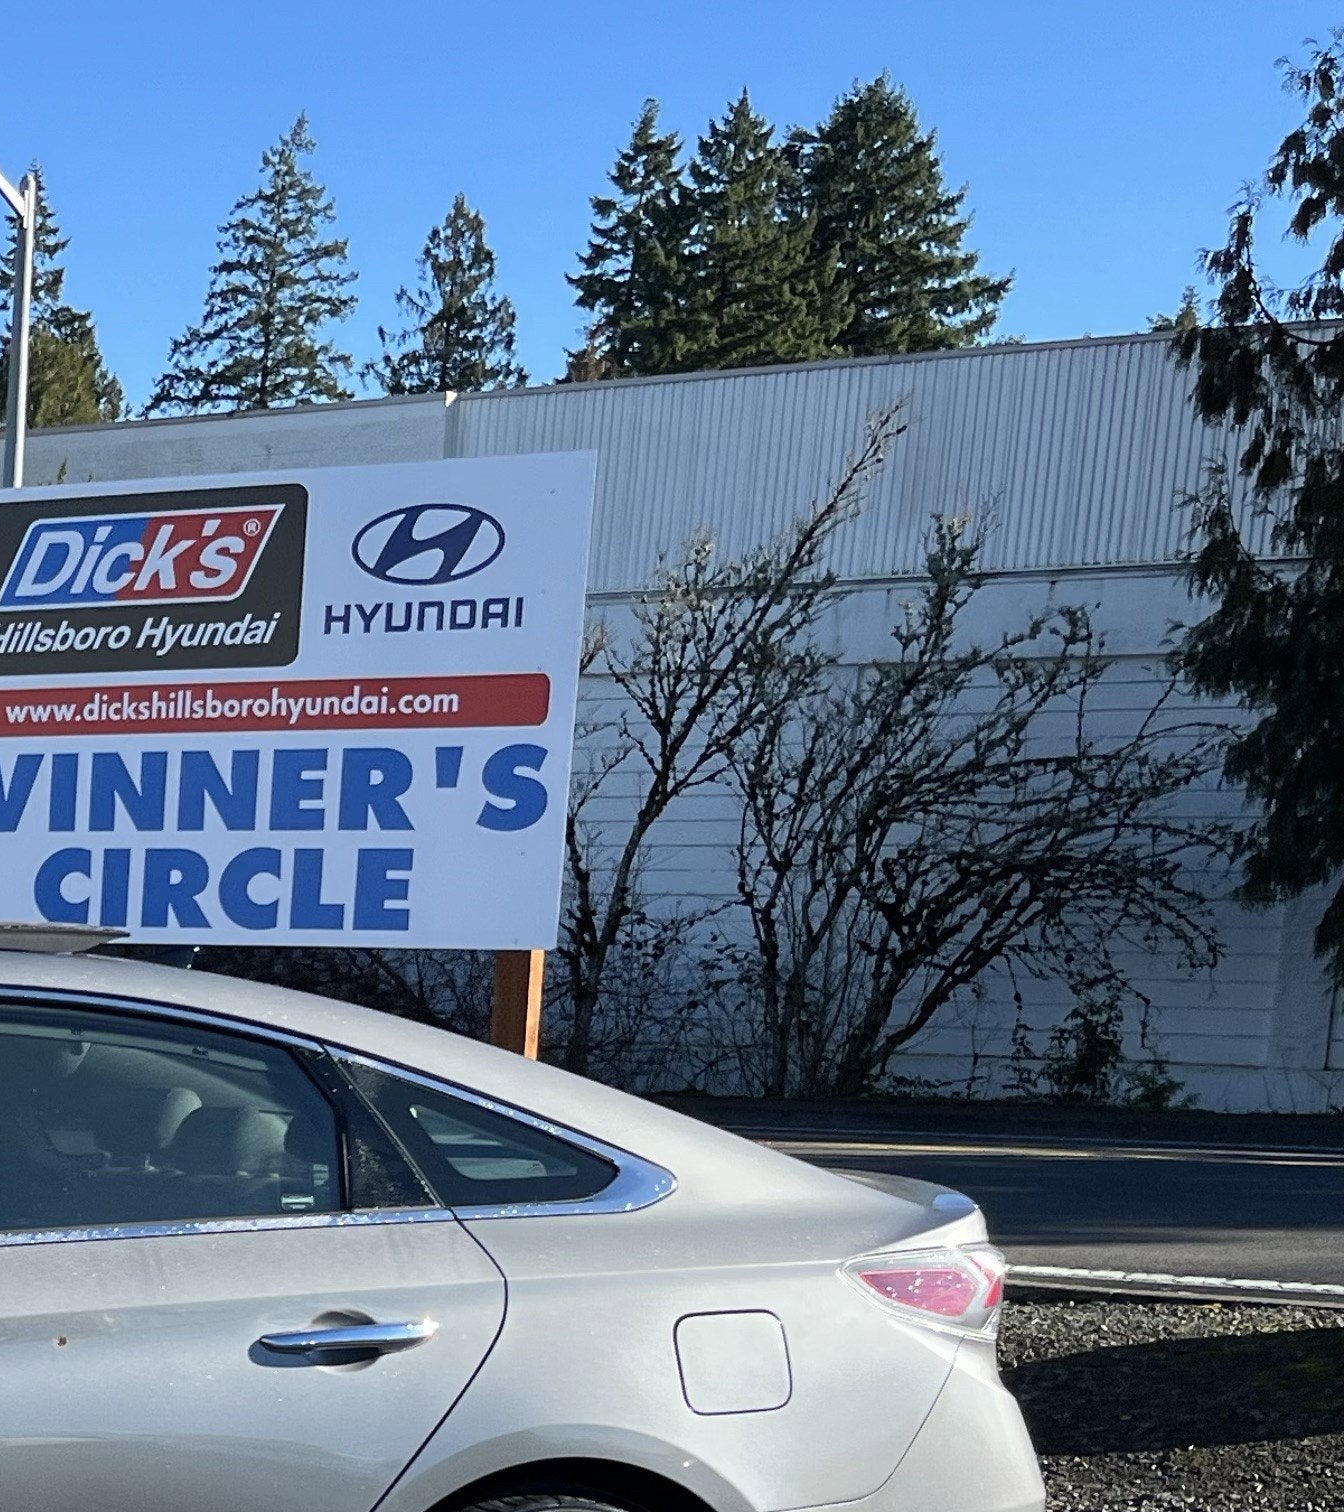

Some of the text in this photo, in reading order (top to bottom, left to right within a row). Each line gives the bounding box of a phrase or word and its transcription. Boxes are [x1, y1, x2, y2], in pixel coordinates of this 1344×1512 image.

[14, 519, 246, 598] Dick's
[135, 612, 282, 656] Hyundai
[324, 597, 524, 635] HYUNDAI
[5, 686, 459, 724] www.dickshillsborohyundai.com
[34, 847, 414, 931] CIRCLE
